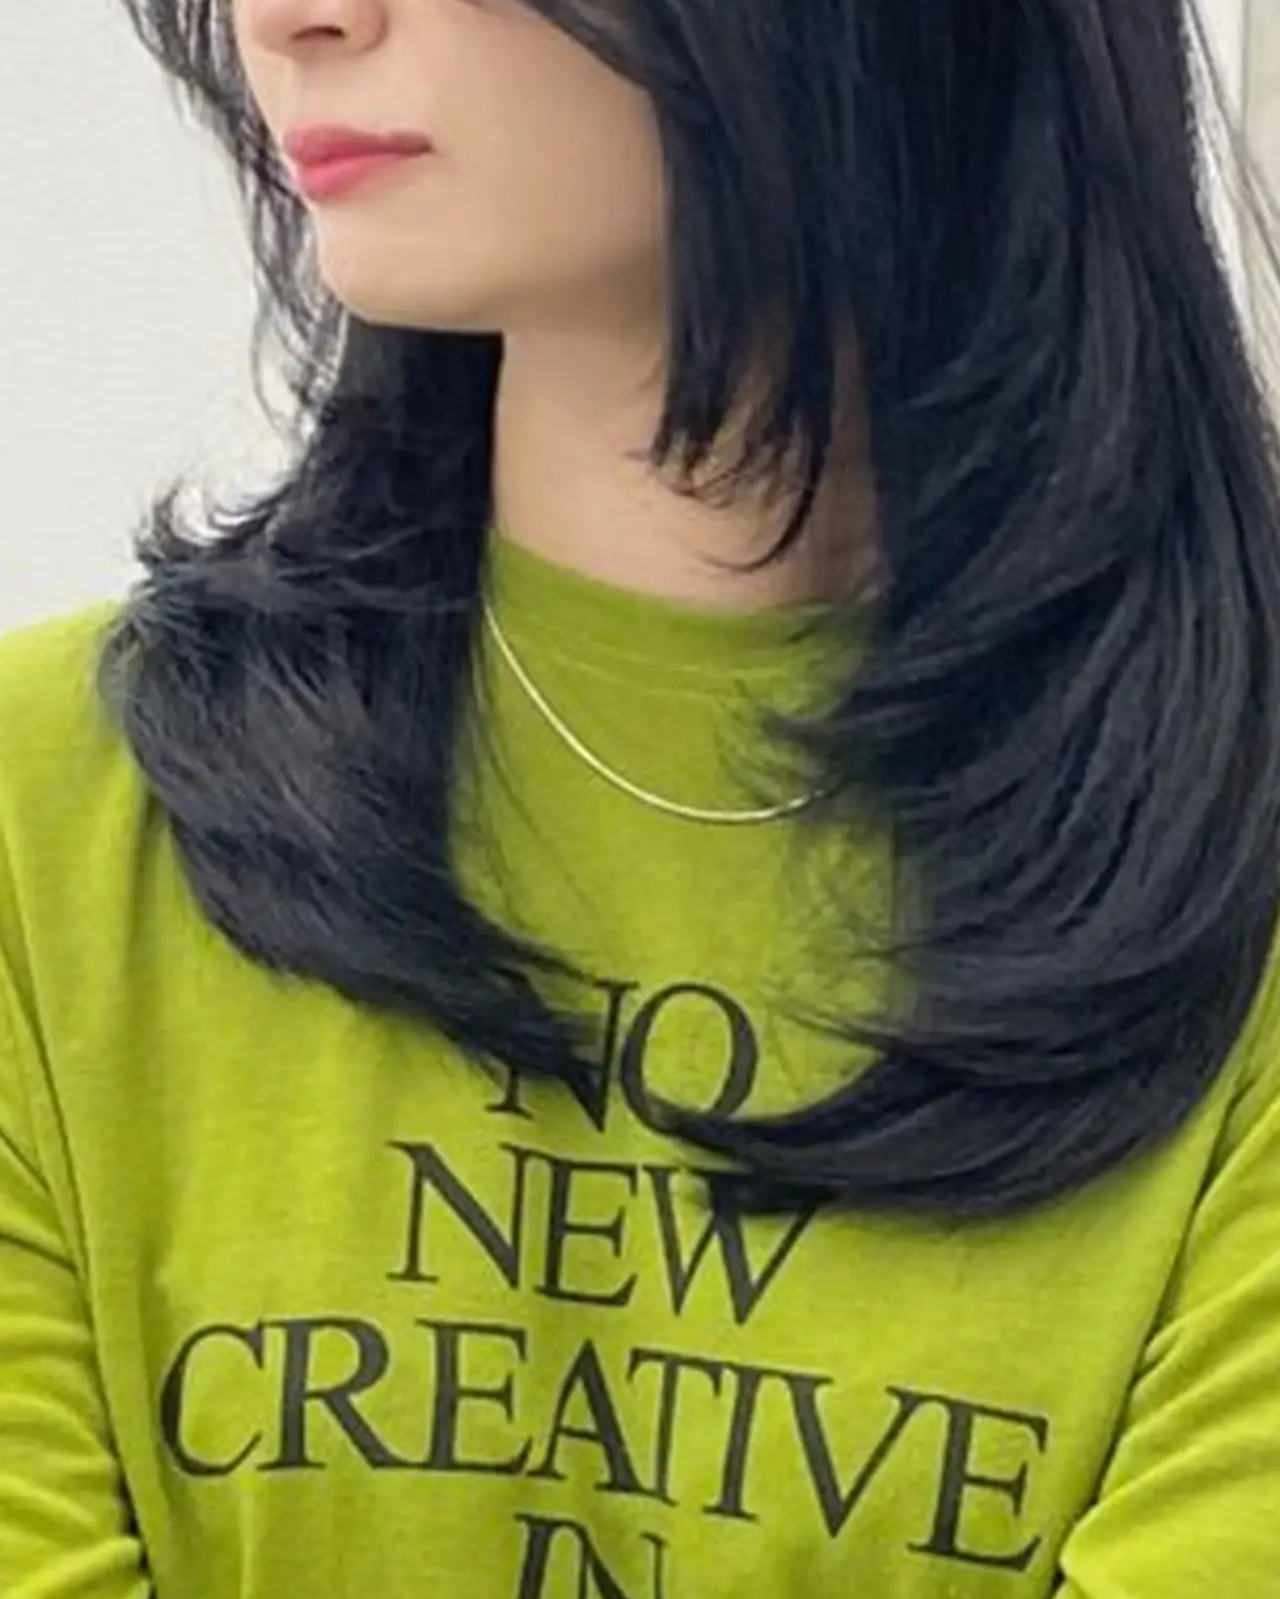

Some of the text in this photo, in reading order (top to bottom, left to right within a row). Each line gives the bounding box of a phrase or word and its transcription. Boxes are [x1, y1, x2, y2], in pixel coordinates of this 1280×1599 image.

[486, 982, 759, 1133] NO
[384, 1140, 838, 1327] NEW
[160, 1316, 1050, 1573] CREATIVE
